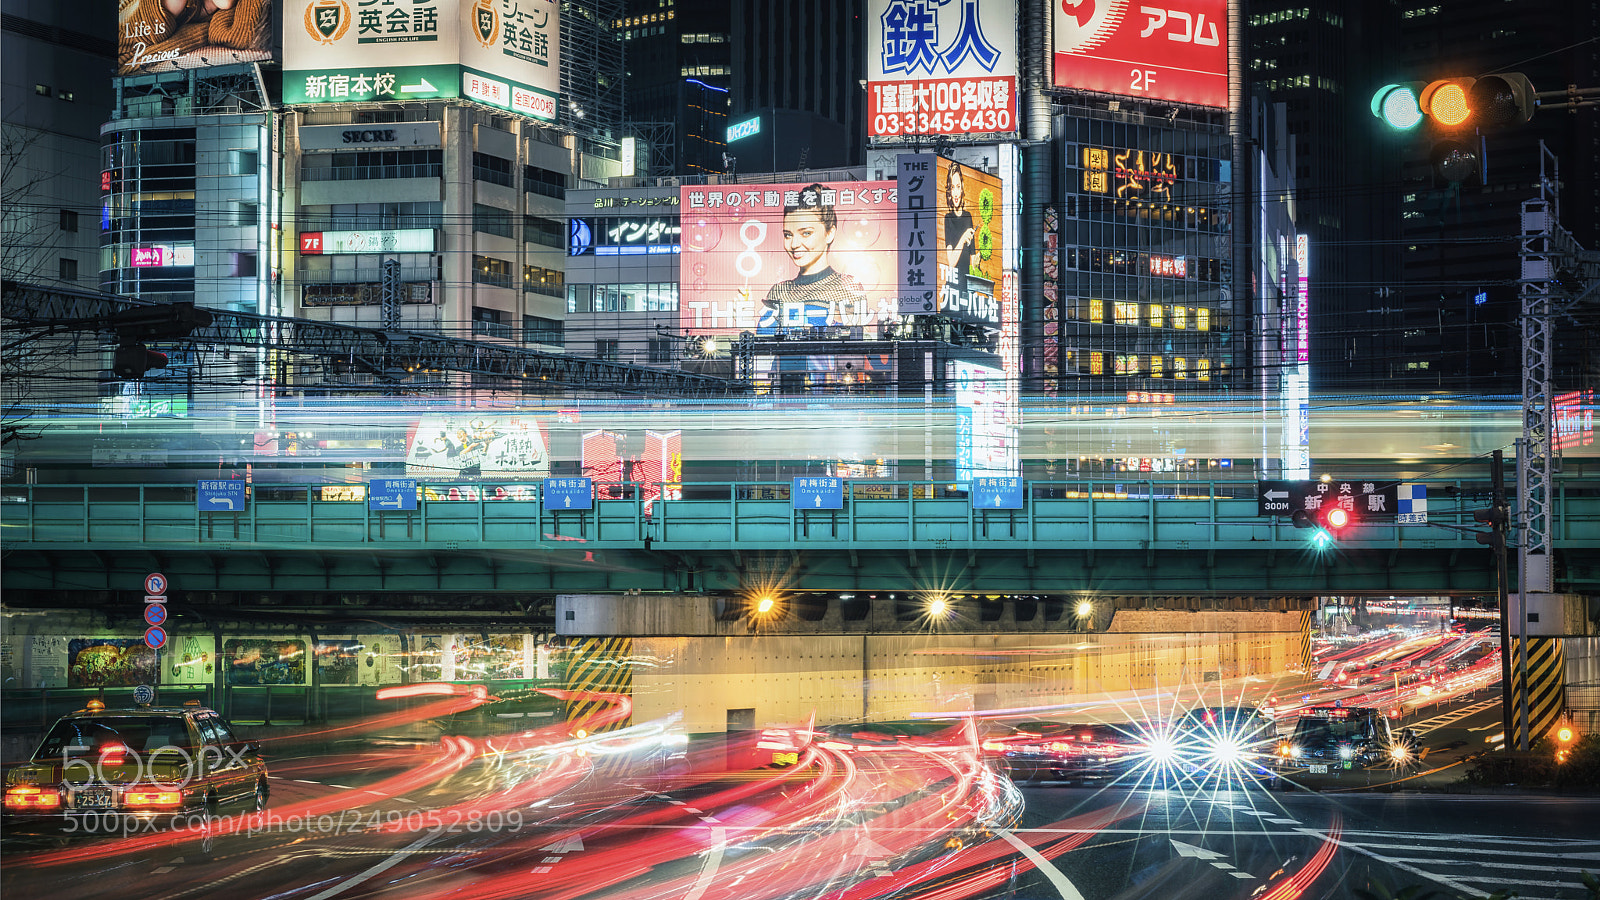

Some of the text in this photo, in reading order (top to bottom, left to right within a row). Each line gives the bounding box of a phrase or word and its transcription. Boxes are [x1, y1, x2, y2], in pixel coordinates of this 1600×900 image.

[125, 20, 166, 38] Life is
[358, 7, 438, 34] 英会話
[1140, 6, 1220, 46] アコム
[503, 21, 549, 58] 英会話
[880, 0, 1002, 75] 鉄人
[133, 42, 180, 67] Precious
[305, 72, 396, 98] 新宿本校
[1130, 68, 1156, 91] 2F
[515, 92, 554, 114] 全国200校
[874, 80, 1010, 114] 1室最大100名収容
[874, 110, 1010, 134] 03-3345-6430
[904, 162, 928, 170] THE
[594, 196, 680, 208] 品川ステーションビル
[689, 188, 898, 208] 世界の不動産を面白くする
[907, 175, 926, 286] グローバル社
[304, 238, 320, 248] 7F
[939, 264, 959, 285] THE
[899, 296, 922, 306] global
[688, 300, 756, 328] THE
[800, 478, 837, 488] 青梅街道
[979, 478, 1017, 487] 青梅街道
[1317, 482, 1374, 494] 中央線
[1304, 494, 1386, 512] 新宿駅
[1399, 514, 1426, 522] 時差式
[82, 796, 110, 806] 25-67
